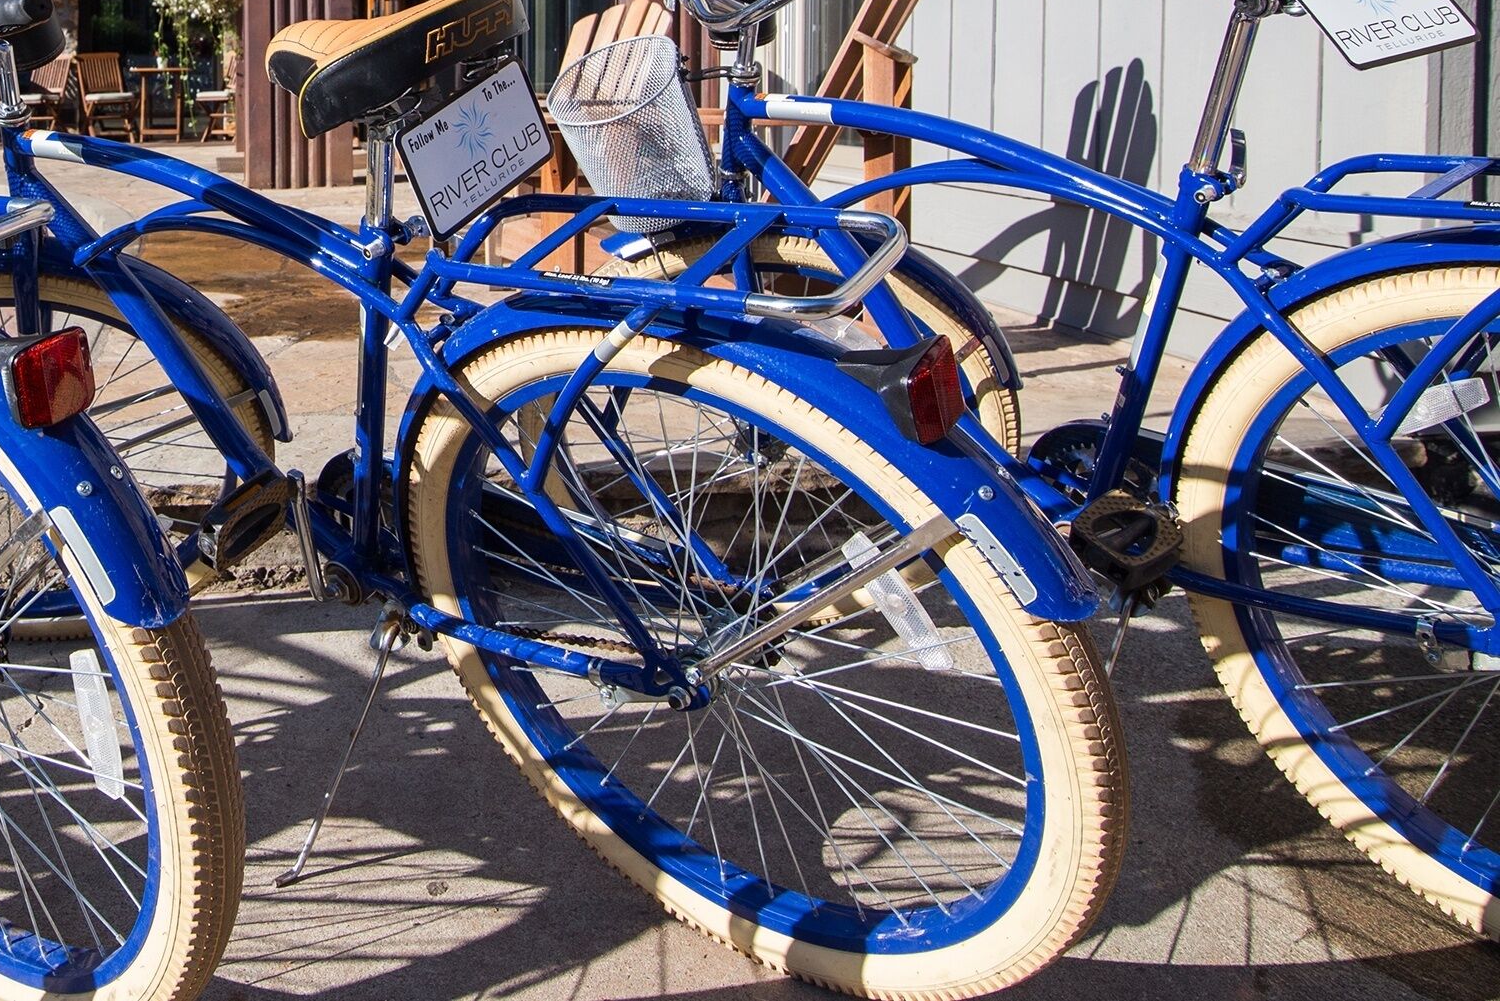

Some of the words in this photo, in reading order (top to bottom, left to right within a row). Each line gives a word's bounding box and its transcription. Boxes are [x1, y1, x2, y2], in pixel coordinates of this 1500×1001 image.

[1335, 19, 1404, 50] RIVER
[1401, 6, 1461, 32] CLUB
[1376, 29, 1446, 52] TELLURIDE
[407, 129, 435, 154] Follow
[434, 119, 449, 136] Me
[482, 87, 493, 103] To
[492, 78, 516, 96] The...
[429, 160, 491, 217] RIVER
[491, 122, 542, 169] CLUB
[462, 157, 526, 208] TELLURIDE
